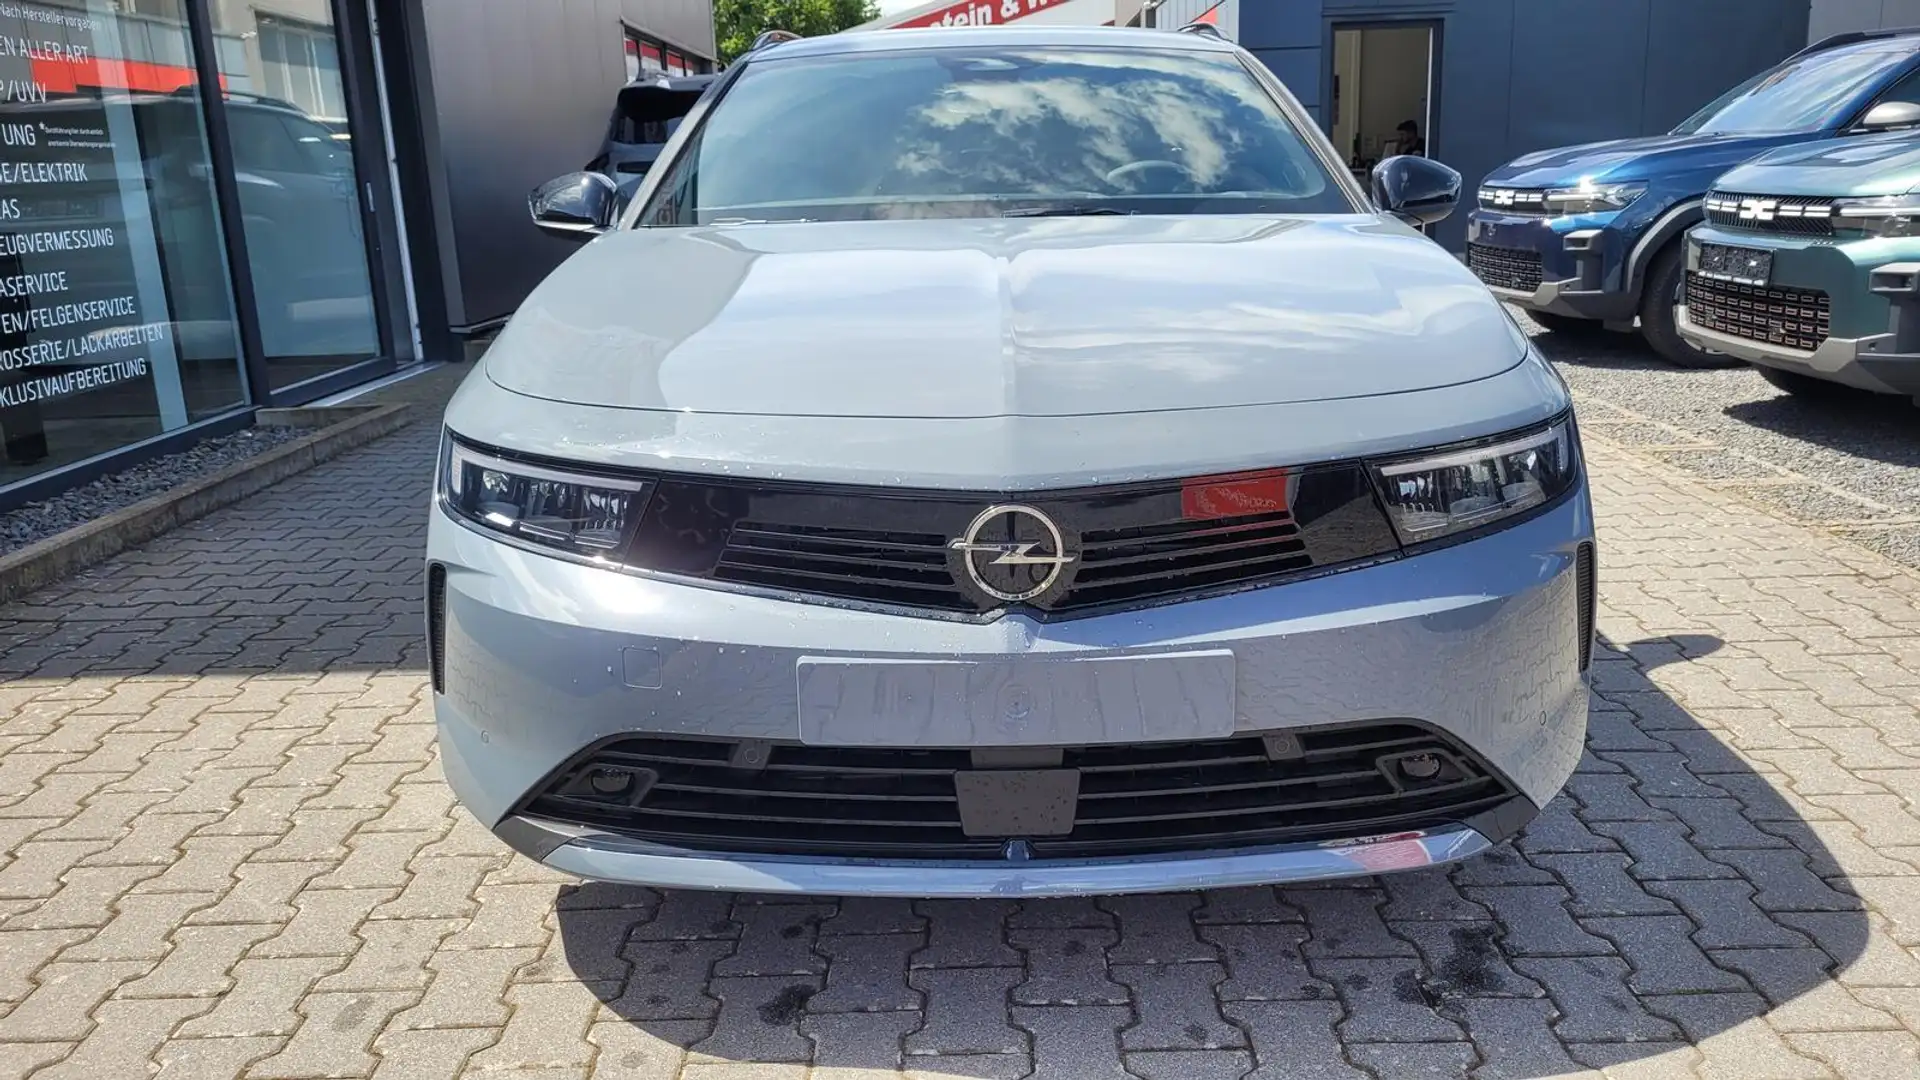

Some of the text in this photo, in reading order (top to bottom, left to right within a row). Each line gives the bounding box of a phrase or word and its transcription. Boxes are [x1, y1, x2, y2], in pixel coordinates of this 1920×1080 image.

[20, 37, 63, 62] ALLER
[65, 43, 89, 65] ART
[0, 163, 88, 183] E/ELEKTRIK
[0, 198, 21, 219] AS
[1, 296, 136, 334] EN/FELGENSERVICE
